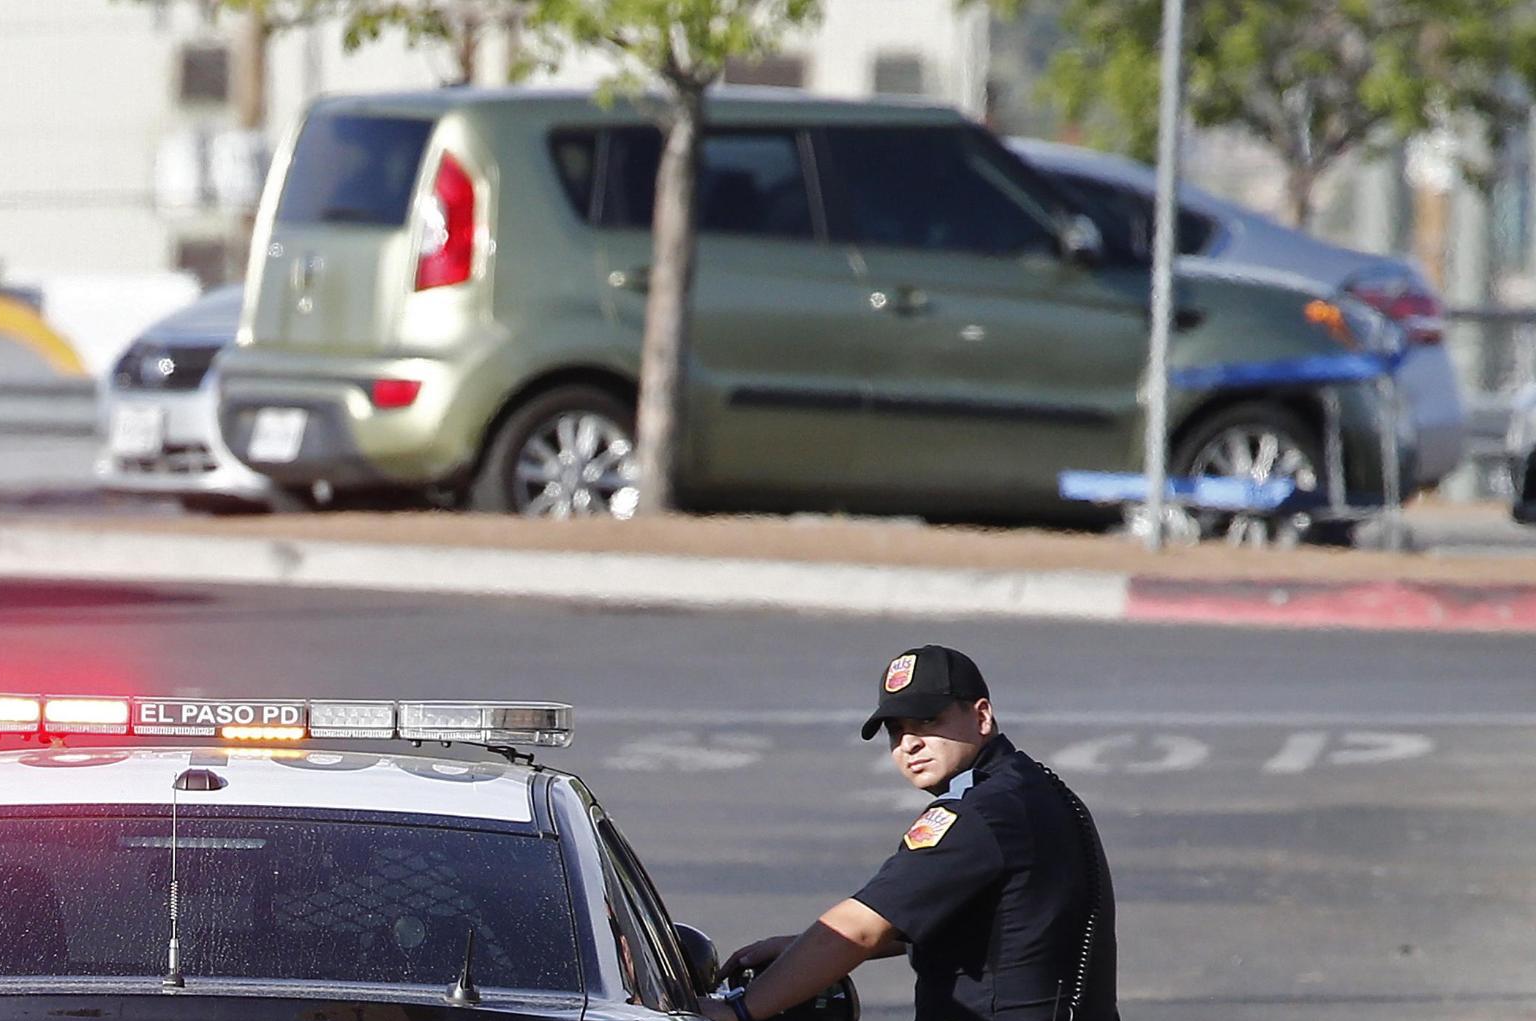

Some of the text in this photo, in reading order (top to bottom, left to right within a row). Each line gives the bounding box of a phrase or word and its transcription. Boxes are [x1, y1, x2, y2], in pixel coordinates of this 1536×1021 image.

[141, 703, 299, 725] EL PASO PD
[604, 729, 1438, 775] SOP
